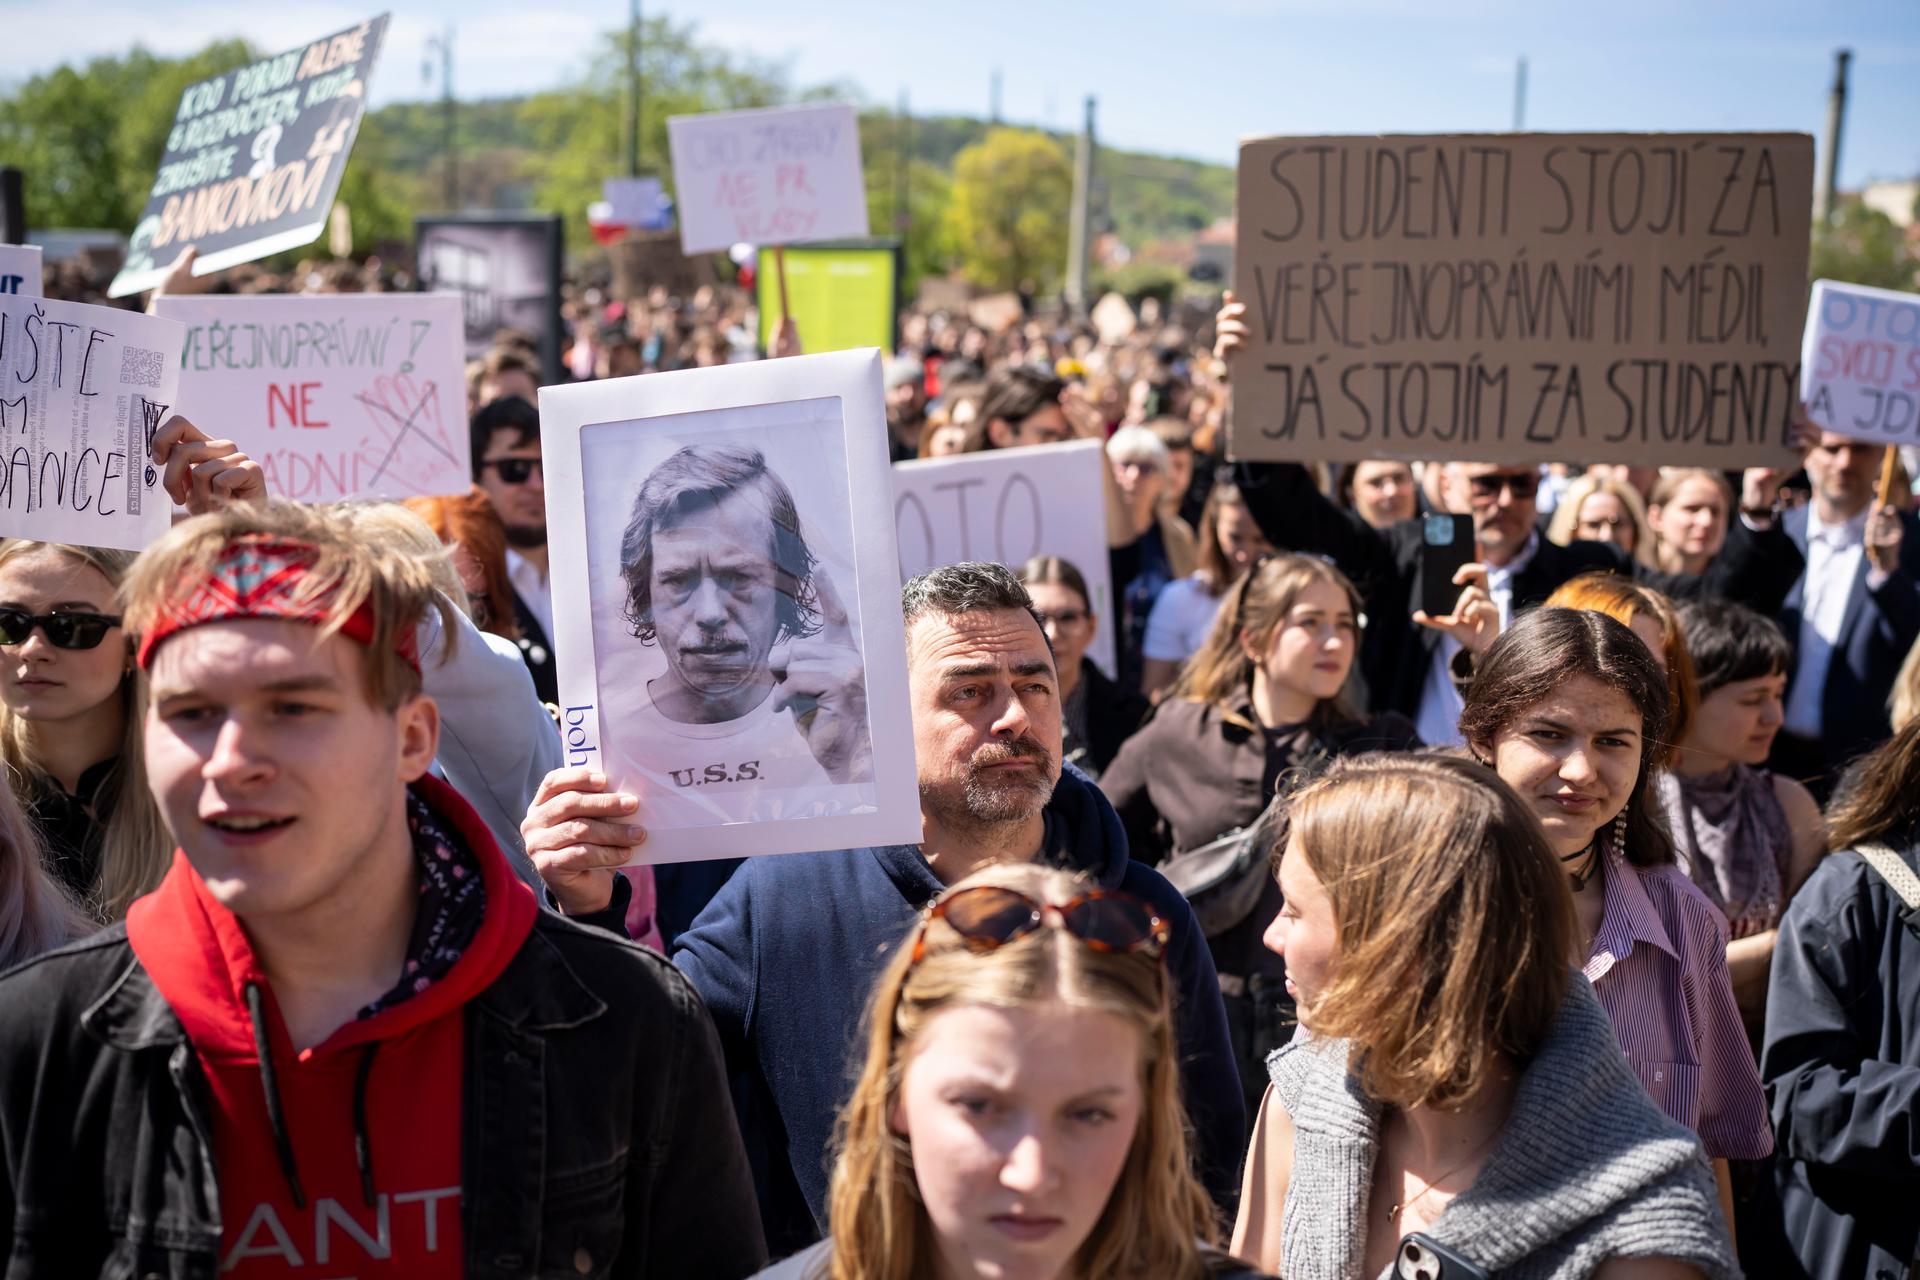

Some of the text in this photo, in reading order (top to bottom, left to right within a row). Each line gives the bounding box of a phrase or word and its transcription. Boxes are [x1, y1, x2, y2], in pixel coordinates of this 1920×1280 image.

[176, 77, 227, 121] KDO
[713, 162, 817, 209] NE PR
[1261, 140, 1781, 243] STUDENTI STOJÍ ZA
[1253, 247, 1635, 350] VEŘEJNOPRÁVNÍMI
[267, 382, 331, 428] NE
[1261, 351, 1801, 447] JÁ STOJÍM ZA STUDENTY
[668, 759, 766, 788] U.S.S.
